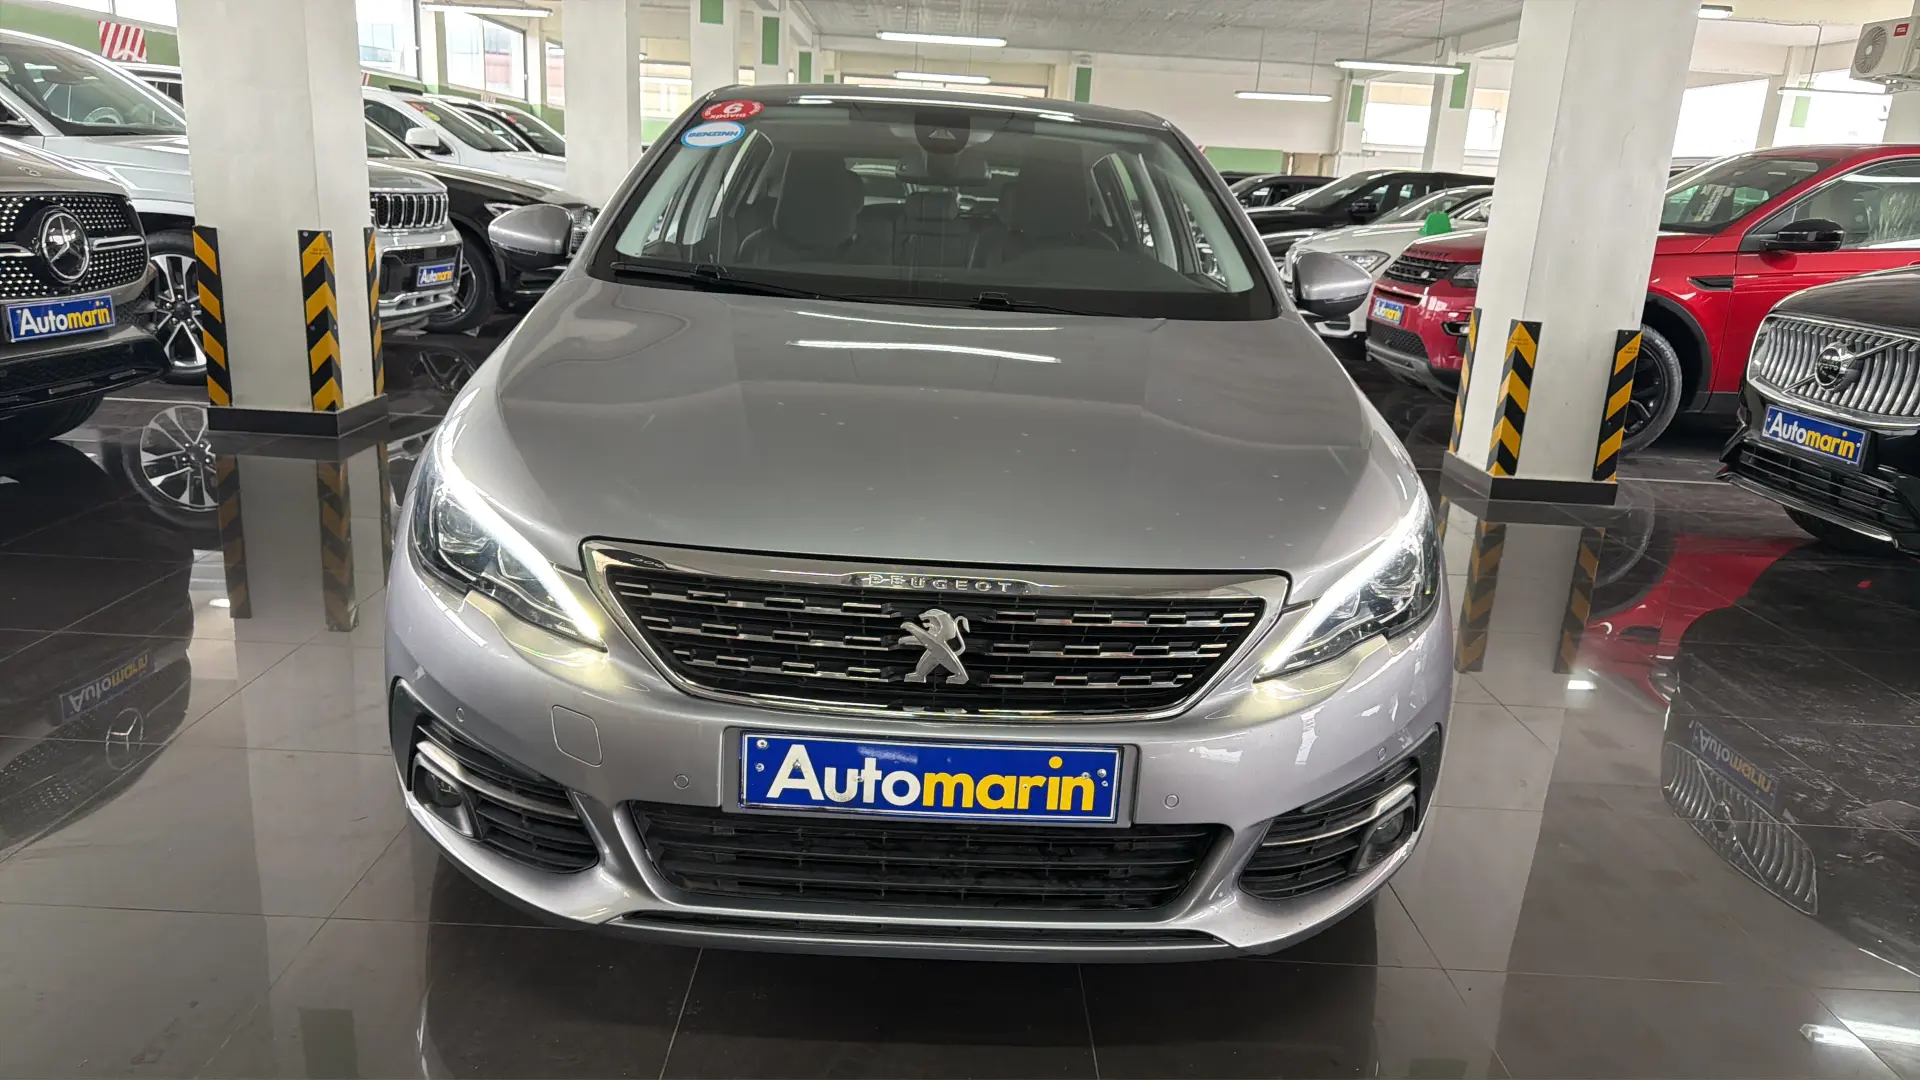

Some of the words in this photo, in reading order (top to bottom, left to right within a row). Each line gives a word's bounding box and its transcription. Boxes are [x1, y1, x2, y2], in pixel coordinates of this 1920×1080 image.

[723, 102, 744, 114] 6
[20, 300, 111, 336] Automarin
[1768, 411, 1855, 459] Automarin
[867, 573, 1012, 593] PEUGEOT
[766, 743, 1096, 811] Automarin
